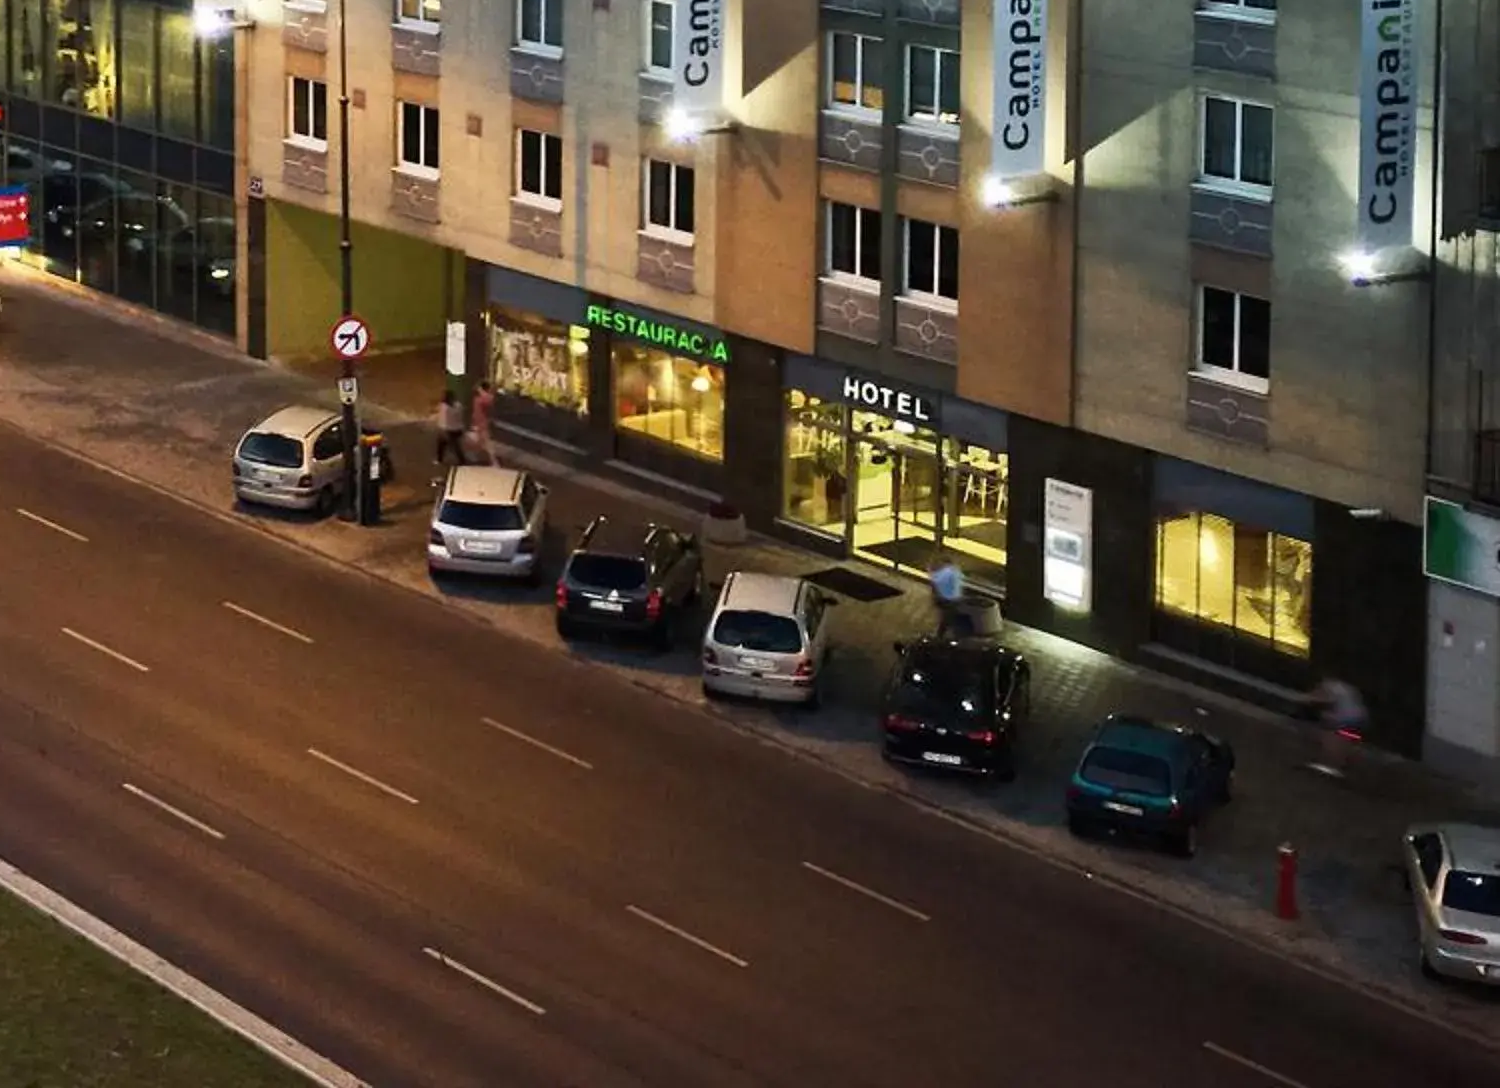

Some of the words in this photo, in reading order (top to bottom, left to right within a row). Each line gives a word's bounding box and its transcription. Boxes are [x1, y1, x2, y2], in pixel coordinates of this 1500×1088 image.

[1032, 50, 1042, 109] HOTEL
[1401, 113, 1411, 177] HOTEL
[587, 305, 728, 361] RESTAURACA
[843, 376, 930, 422] HOTEL
